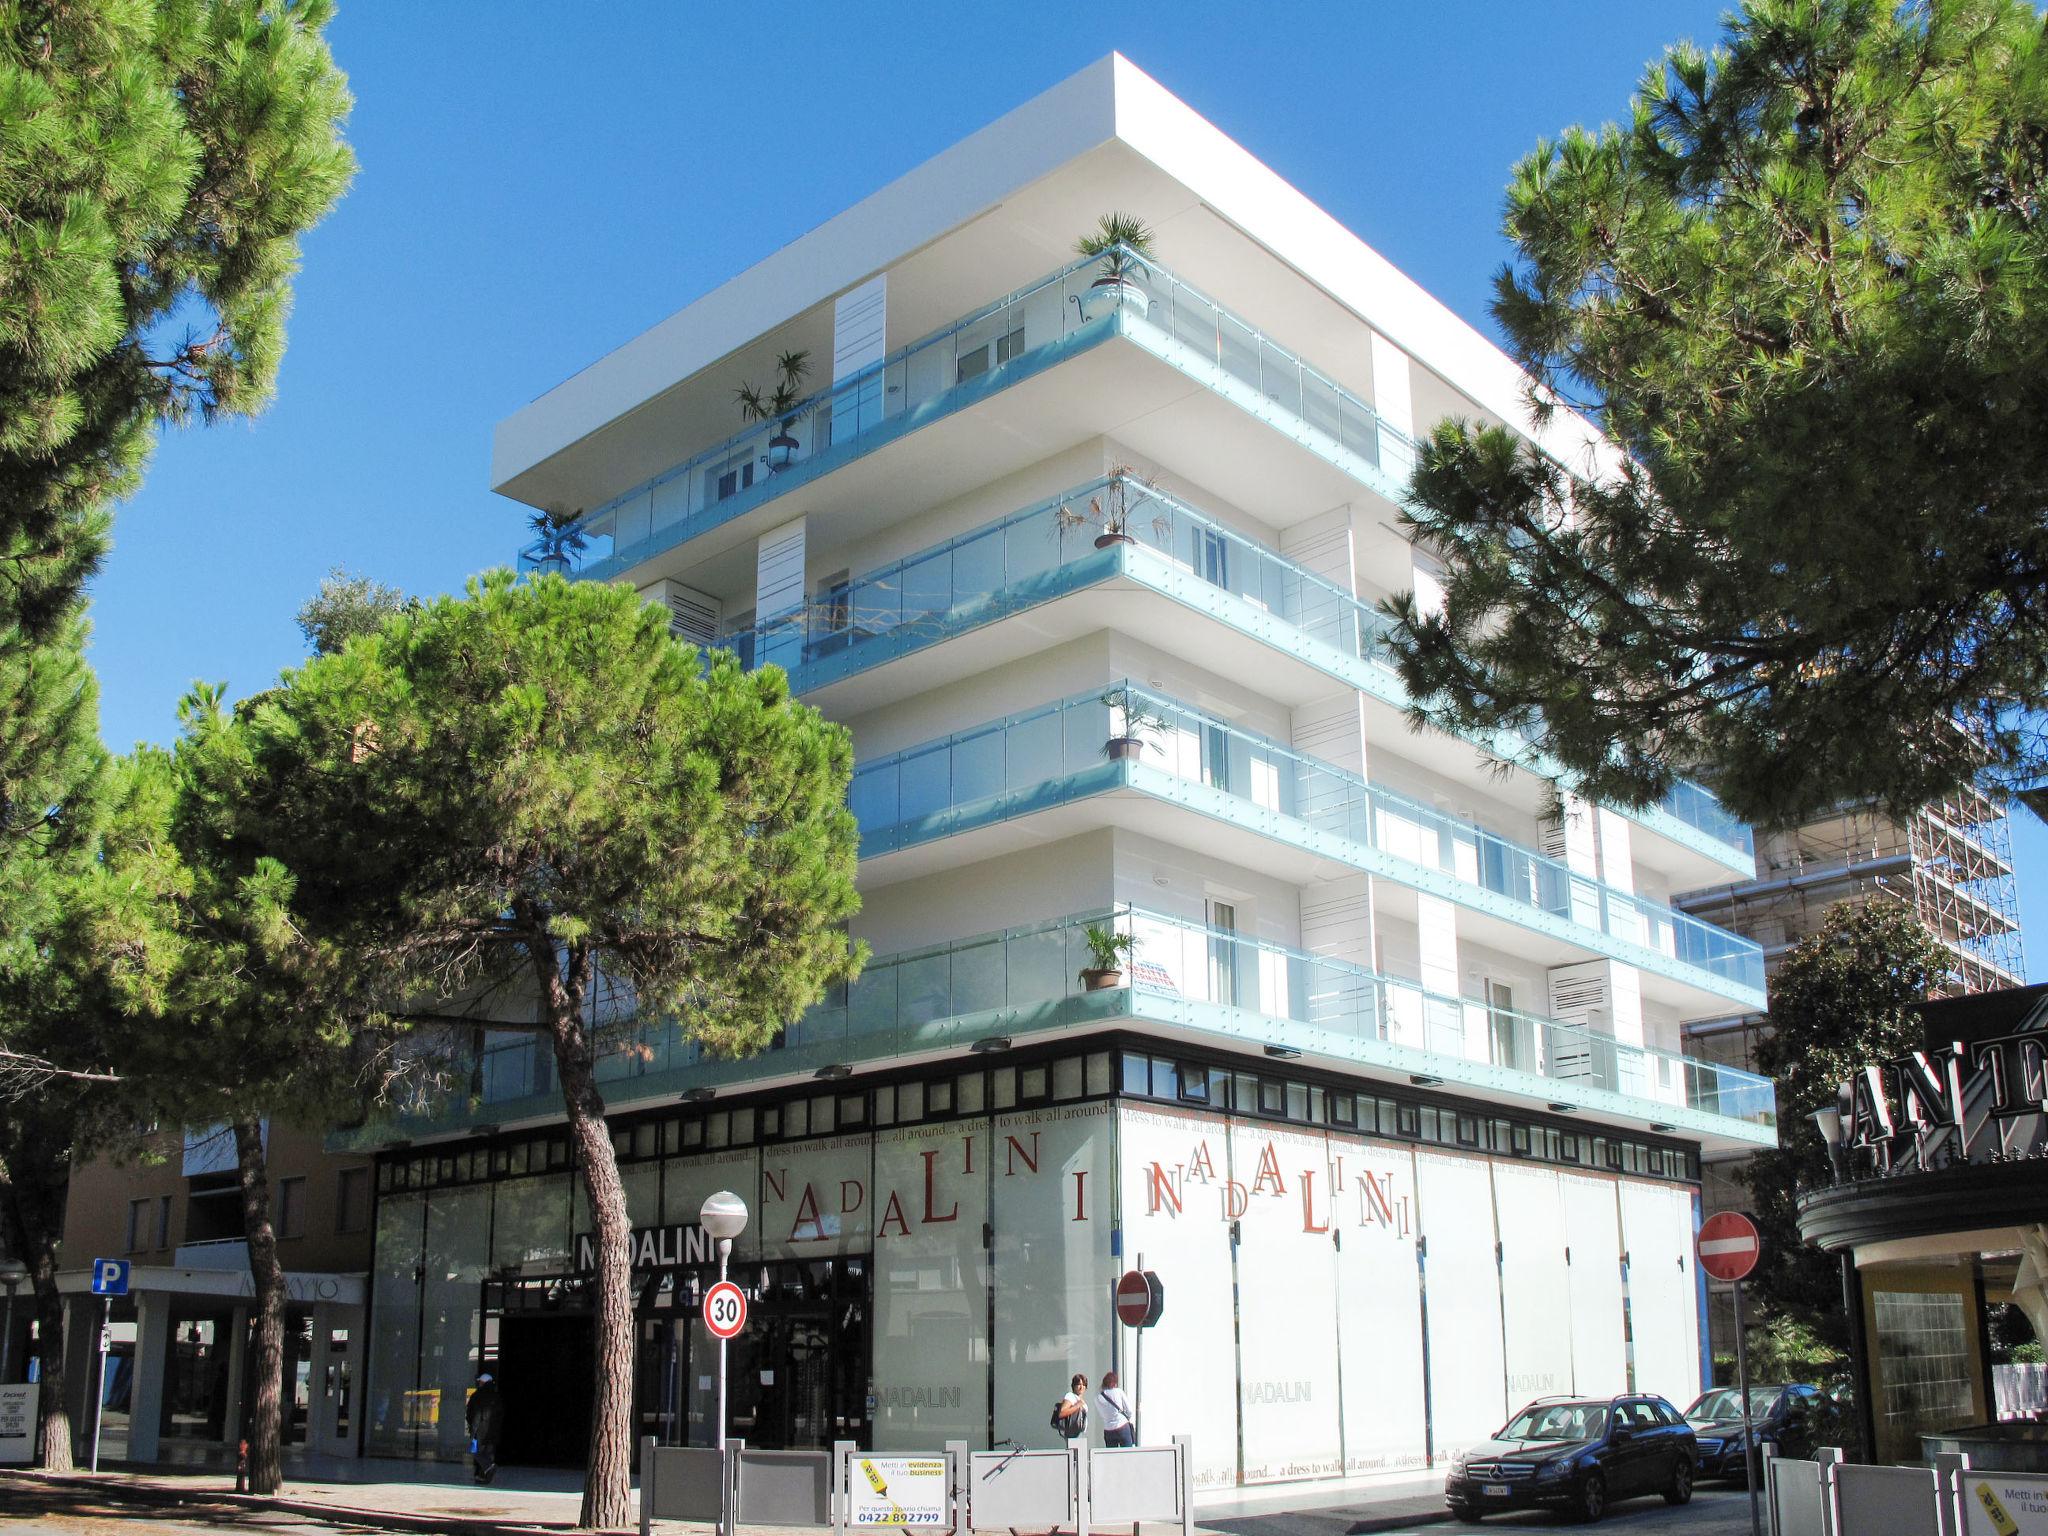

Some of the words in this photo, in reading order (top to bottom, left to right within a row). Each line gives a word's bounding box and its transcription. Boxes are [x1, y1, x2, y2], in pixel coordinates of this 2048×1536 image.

[805, 1136, 828, 1152] walk
[892, 1127, 904, 1141] all
[1000, 1115, 1011, 1128] to
[1014, 1109, 1042, 1125] walk
[1047, 1107, 1060, 1122] all
[1148, 1139, 1411, 1233] NADALINI
[581, 1226, 715, 1271] NALINI
[100, 1262, 120, 1290] P
[715, 1297, 737, 1322] 30
[908, 1461, 942, 1469] evidenza
[2005, 1488, 2031, 1500] Metti
[917, 1504, 942, 1512] chiama
[2029, 1502, 2046, 1513] tuo
[858, 1513, 889, 1522] 0422
[892, 1513, 939, 1522] 892799
